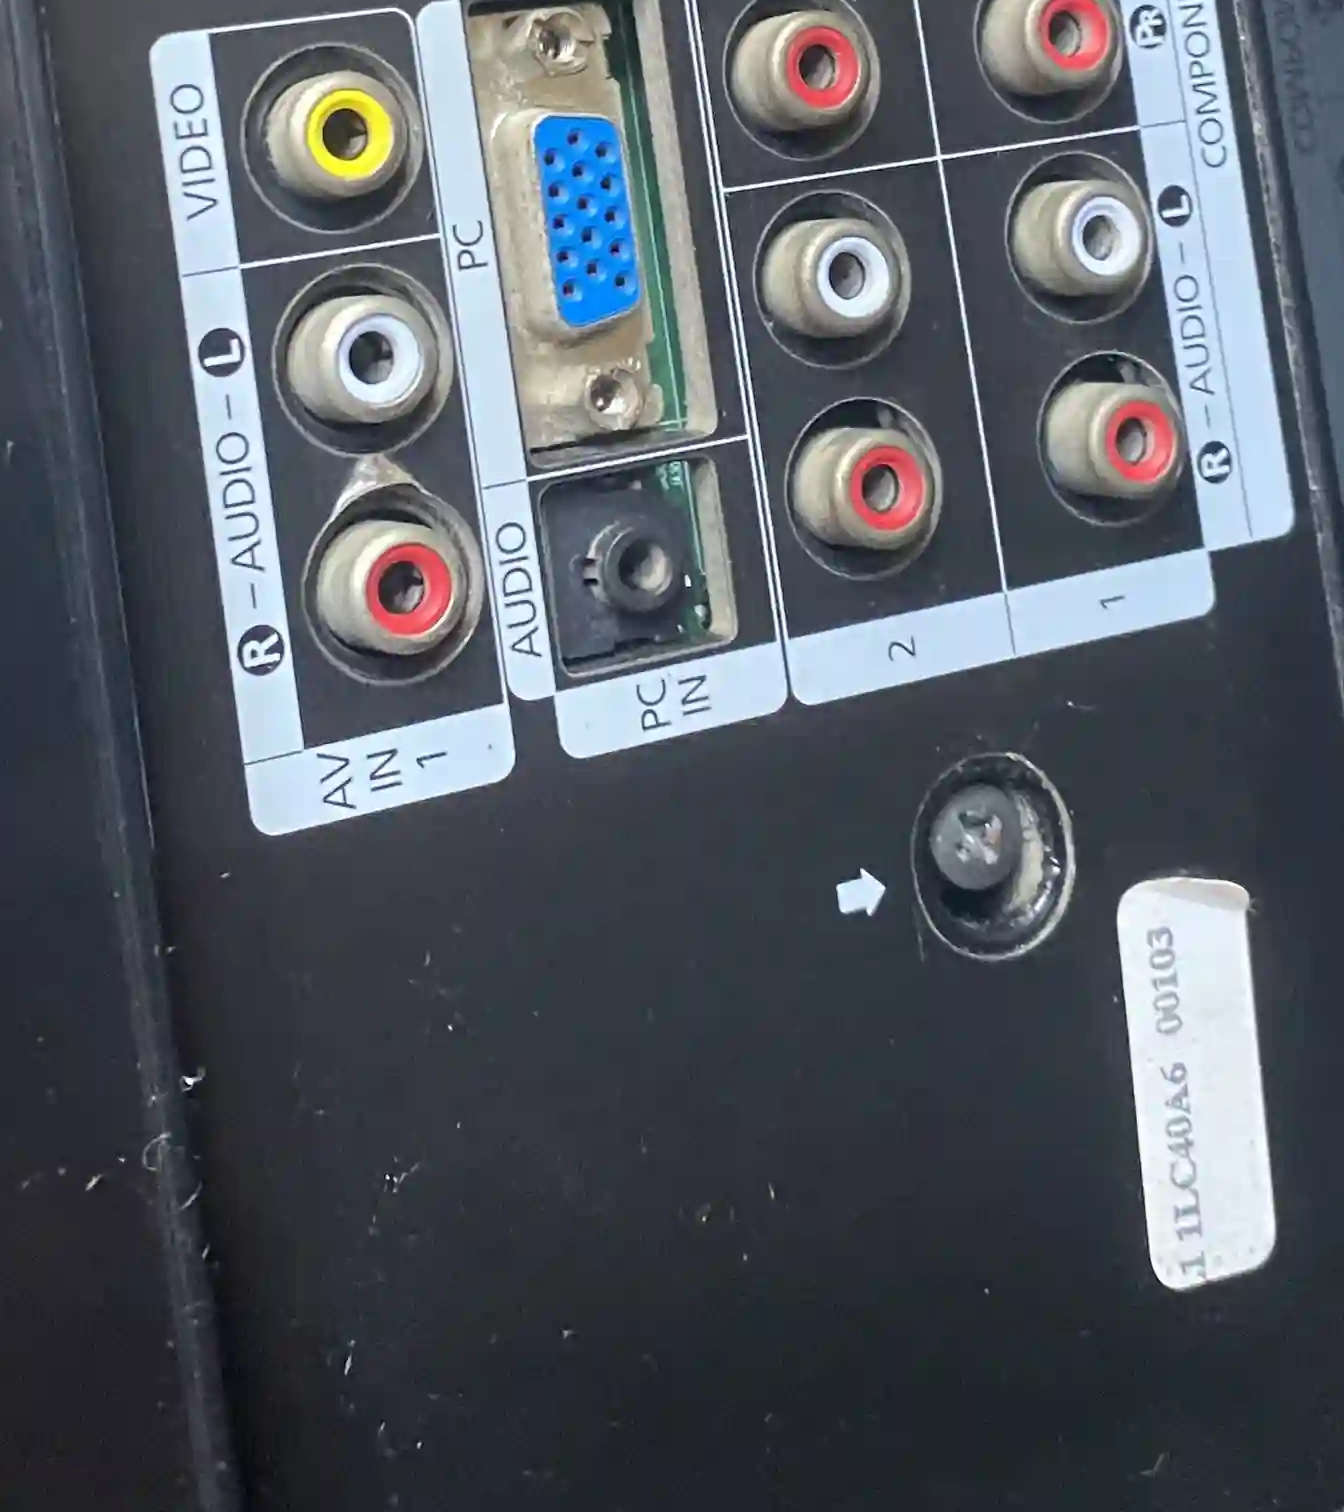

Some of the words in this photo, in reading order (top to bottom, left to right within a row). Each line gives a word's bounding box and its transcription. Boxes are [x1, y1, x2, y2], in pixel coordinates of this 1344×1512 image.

[170, 83, 218, 221] VIDEO
[453, 219, 487, 272] PC
[1172, 273, 1216, 396] AUDIO
[215, 431, 268, 573] AUDIO
[496, 521, 542, 658] AUDIO
[1098, 592, 1127, 612] 1
[887, 635, 917, 663] 2
[636, 678, 673, 733] PC
[681, 674, 710, 718] IN
[317, 752, 357, 810] AV
[366, 747, 402, 793] IN
[415, 746, 448, 772] 1
[1146, 924, 1184, 1036] 00103
